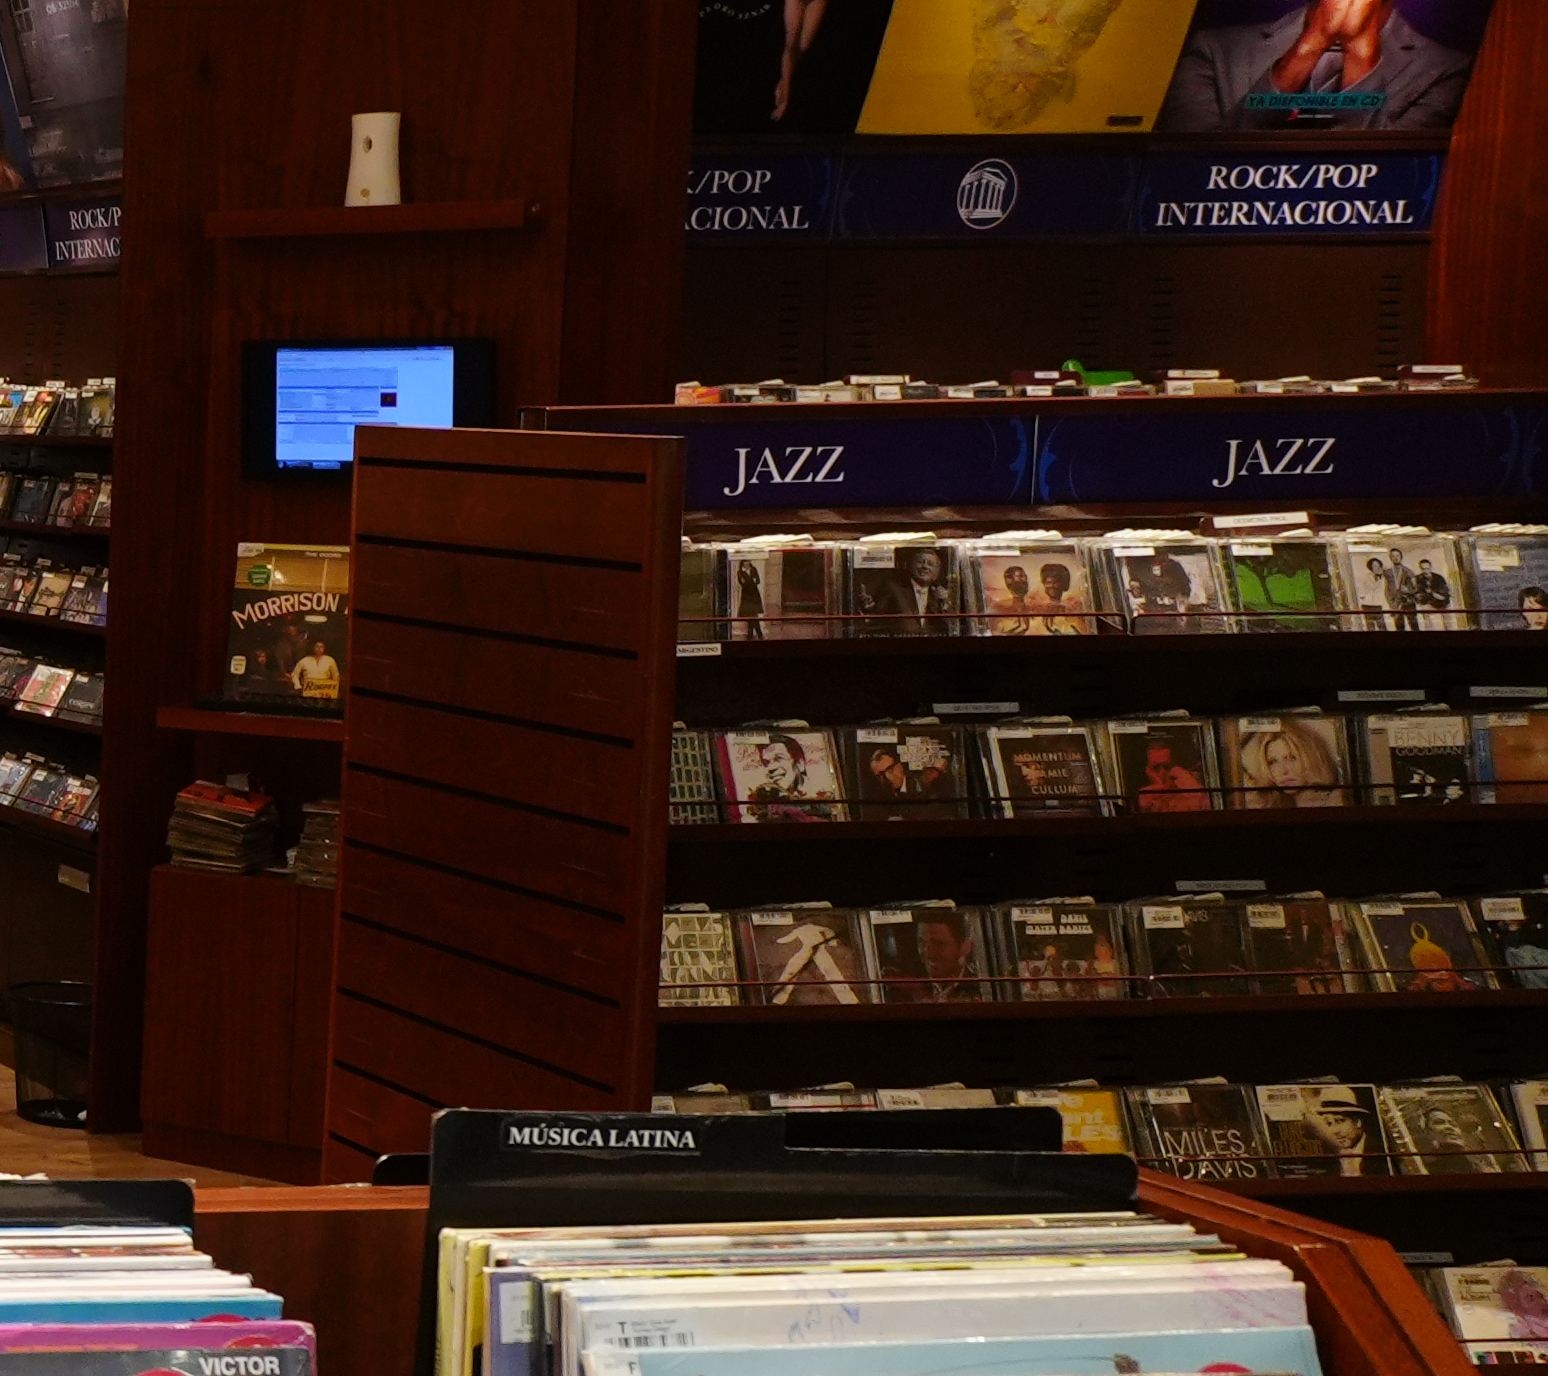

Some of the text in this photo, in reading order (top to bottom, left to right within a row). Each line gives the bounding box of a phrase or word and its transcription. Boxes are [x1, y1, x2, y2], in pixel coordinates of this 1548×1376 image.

[1268, 95, 1338, 107] DISPONIBLE
[1207, 162, 1379, 190] ROCK/POP
[1156, 198, 1415, 227] INTERNACIONAL
[723, 445, 845, 497] JAZZ
[1211, 436, 1336, 491] JAZZ
[231, 592, 341, 629] MORRISON
[1013, 752, 1082, 762] MOMENTUM
[1395, 746, 1463, 756] GOODMAN
[1031, 784, 1079, 794] CULLUM
[508, 1121, 697, 1149] MÚSICA LATINA
[1163, 1128, 1245, 1158] MILES
[198, 1356, 282, 1376] VICTOR
